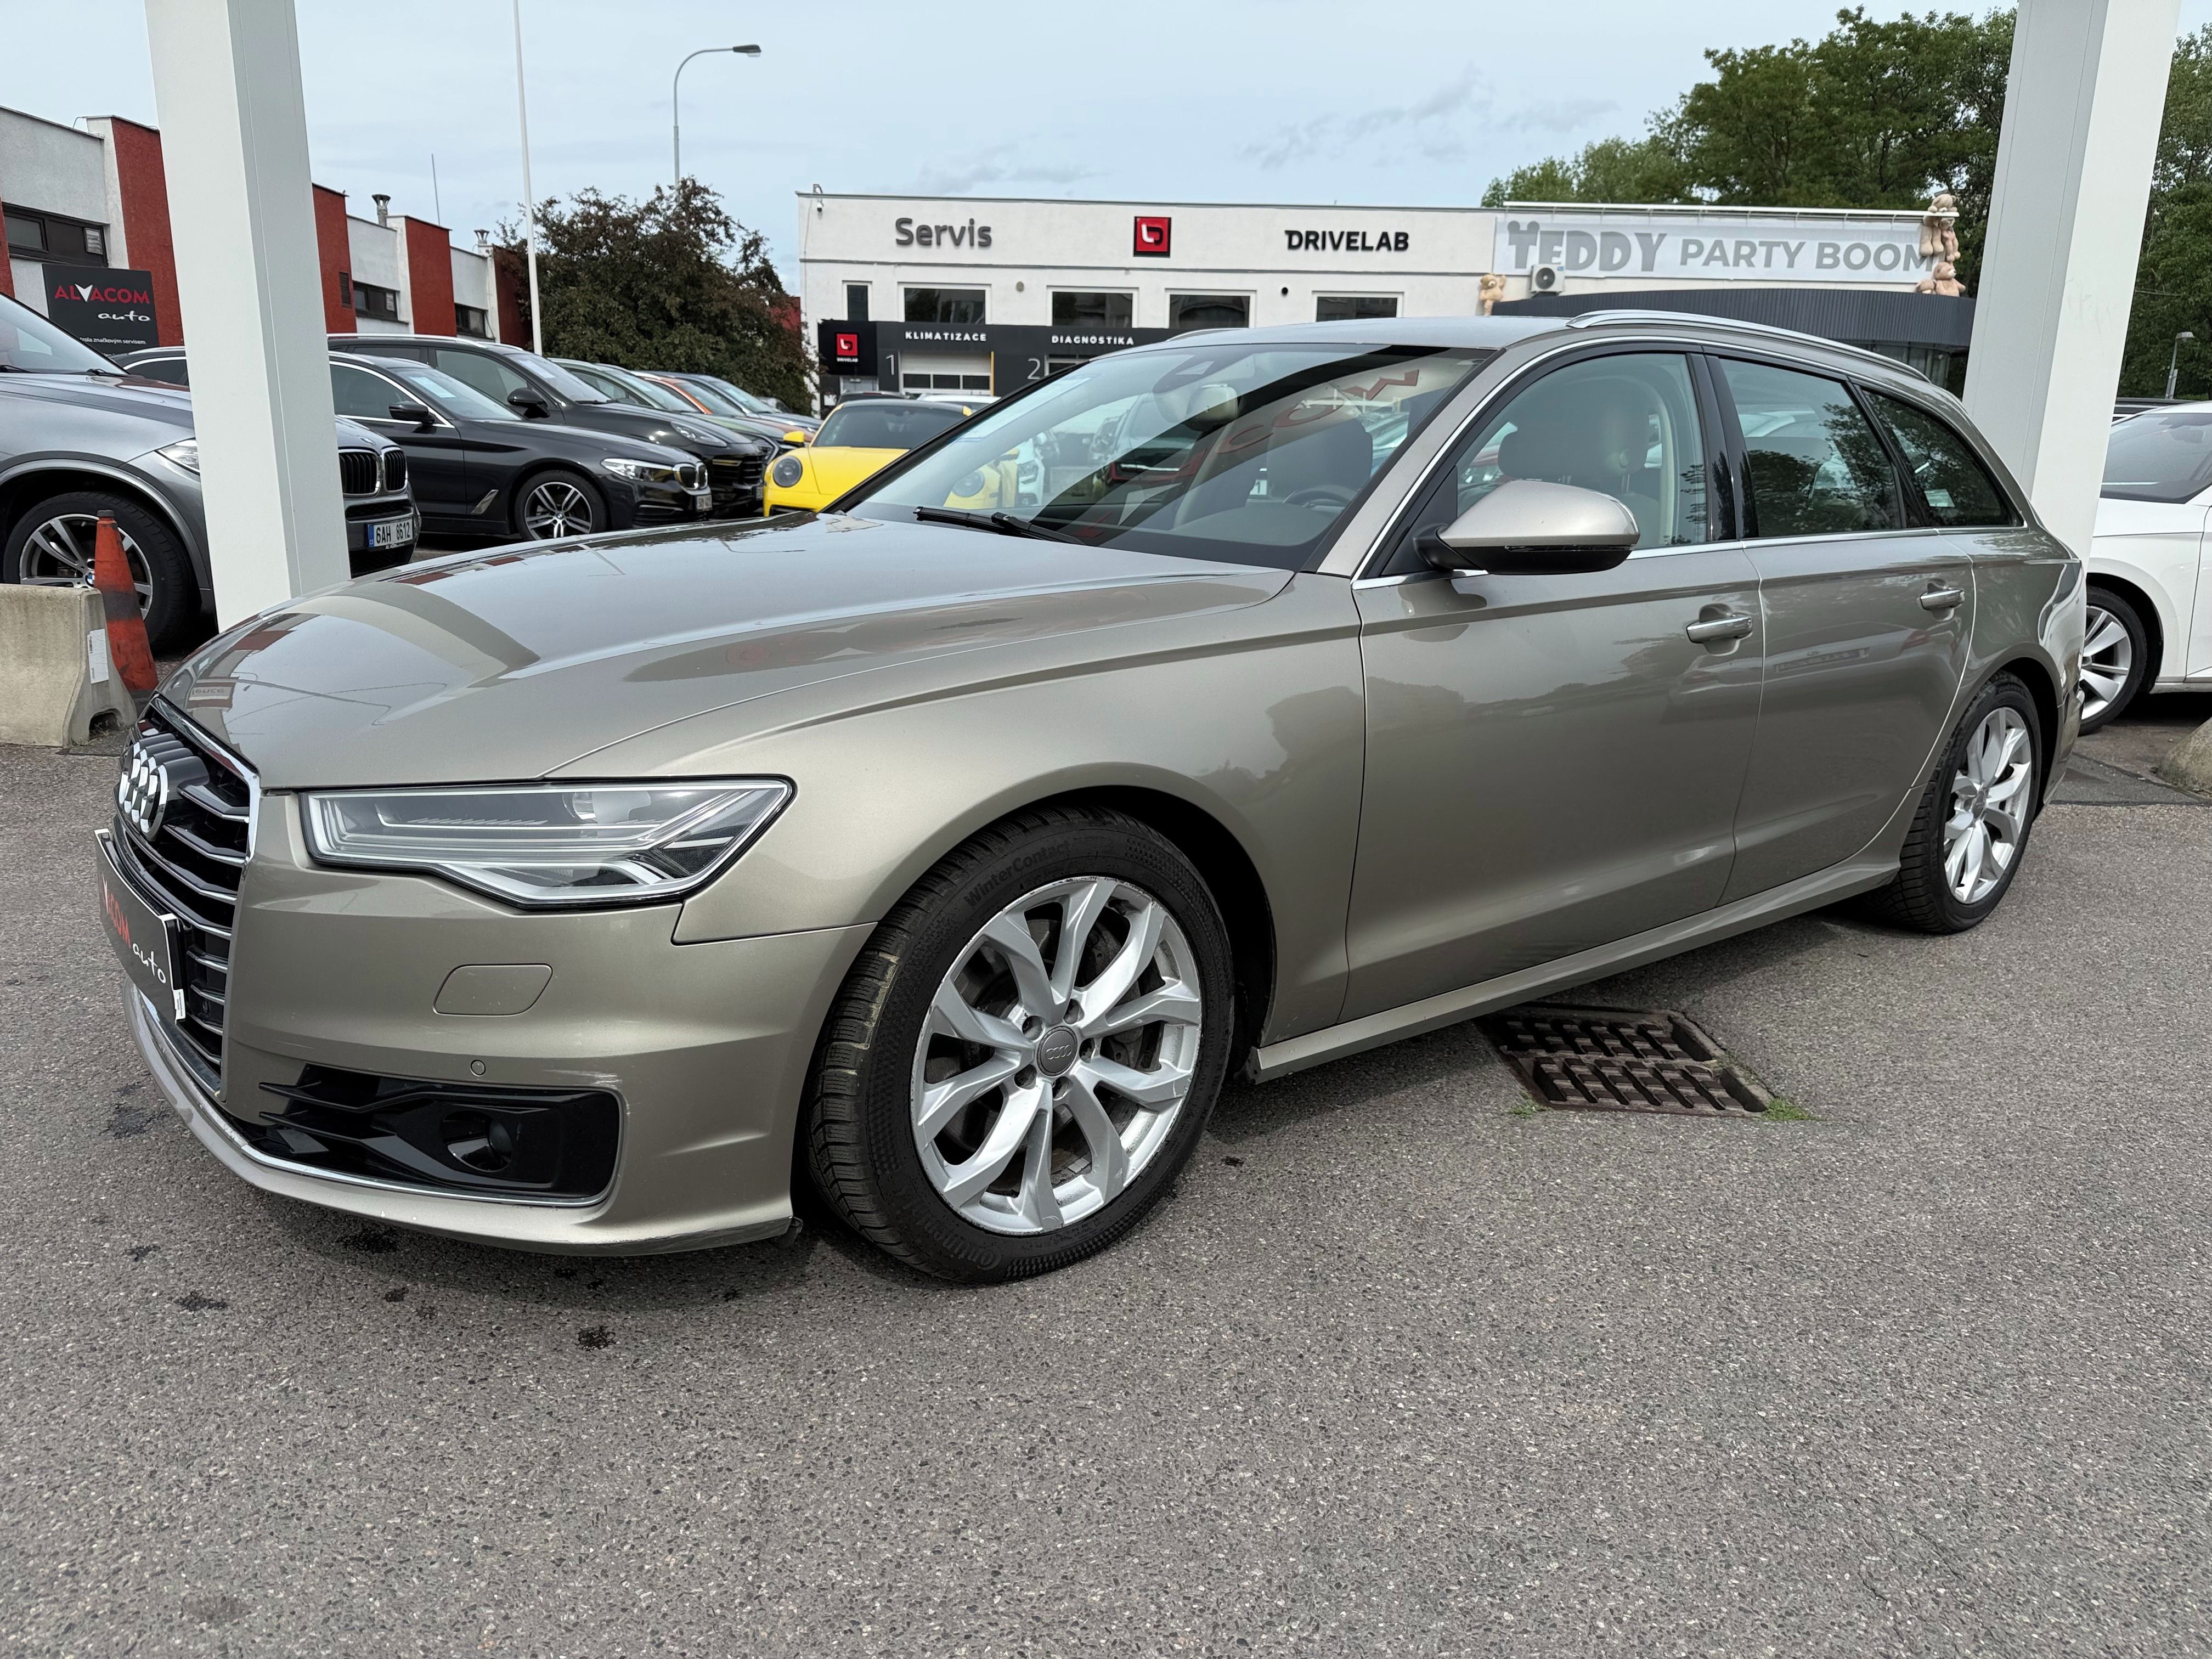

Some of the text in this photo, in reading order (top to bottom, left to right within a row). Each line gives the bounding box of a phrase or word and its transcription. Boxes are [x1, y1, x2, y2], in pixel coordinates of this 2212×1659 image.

[895, 217, 992, 247] Servis
[1284, 230, 1409, 252] DRIVELAB
[1507, 221, 1668, 272] TEDDY
[1680, 238, 1806, 269] PARTY
[54, 283, 150, 304] ALVACOM
[98, 311, 150, 321] auto
[905, 331, 987, 342] KLIMATIZACE
[1051, 334, 1135, 345] DIAGNOSTIKA
[885, 354, 895, 376] 1
[1026, 358, 1041, 380] 2
[376, 522, 410, 544] 6AH 8612
[132, 943, 167, 984] auto
